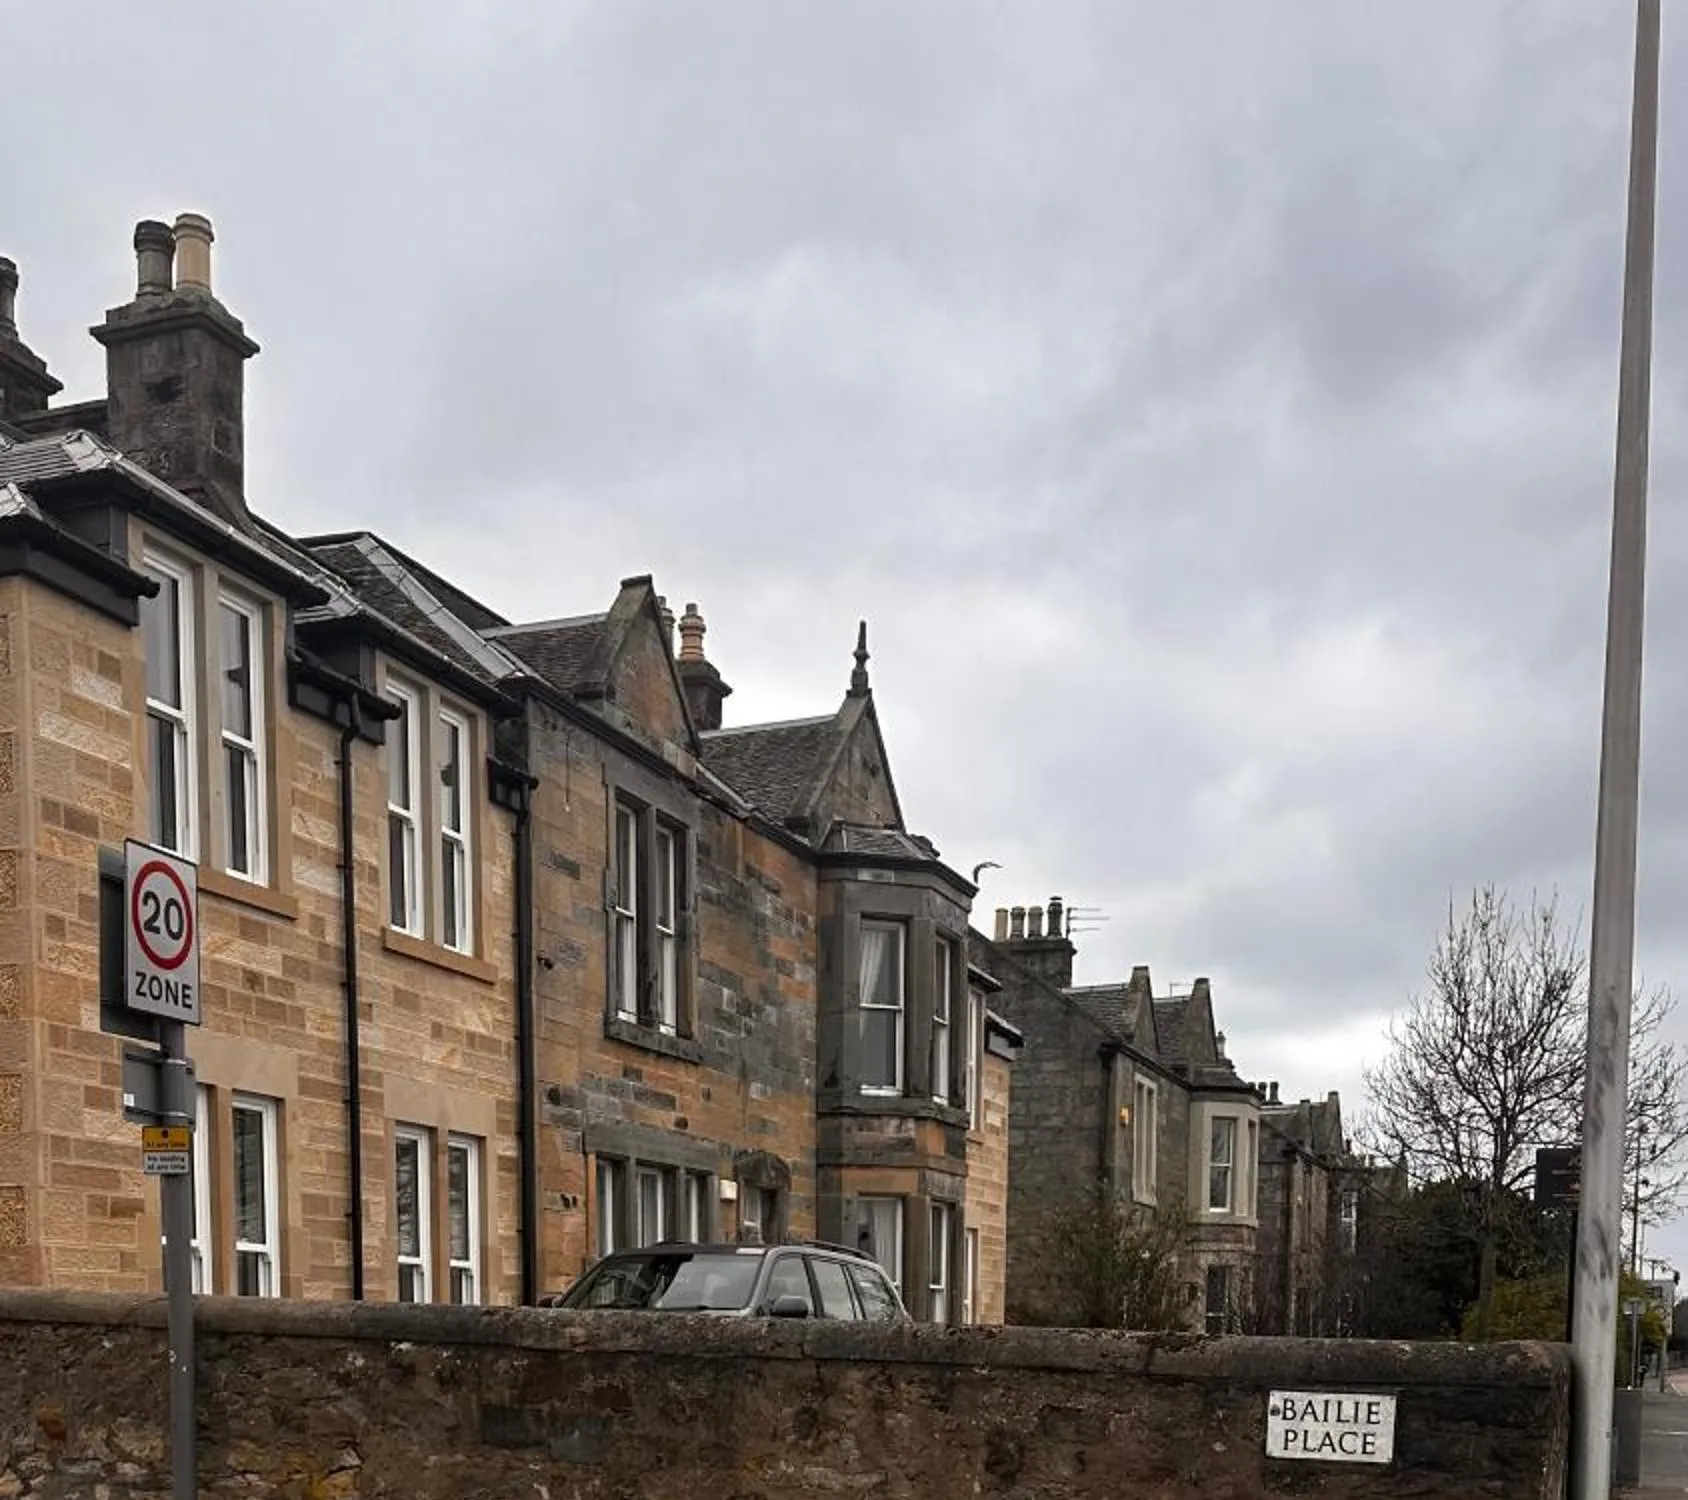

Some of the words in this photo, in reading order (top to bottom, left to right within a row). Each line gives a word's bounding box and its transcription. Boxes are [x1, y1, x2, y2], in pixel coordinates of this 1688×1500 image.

[142, 890, 184, 940] 20
[135, 971, 192, 1009] ZONE
[1281, 1398, 1381, 1425] BAILIE
[1283, 1429, 1377, 1455] PLACE
